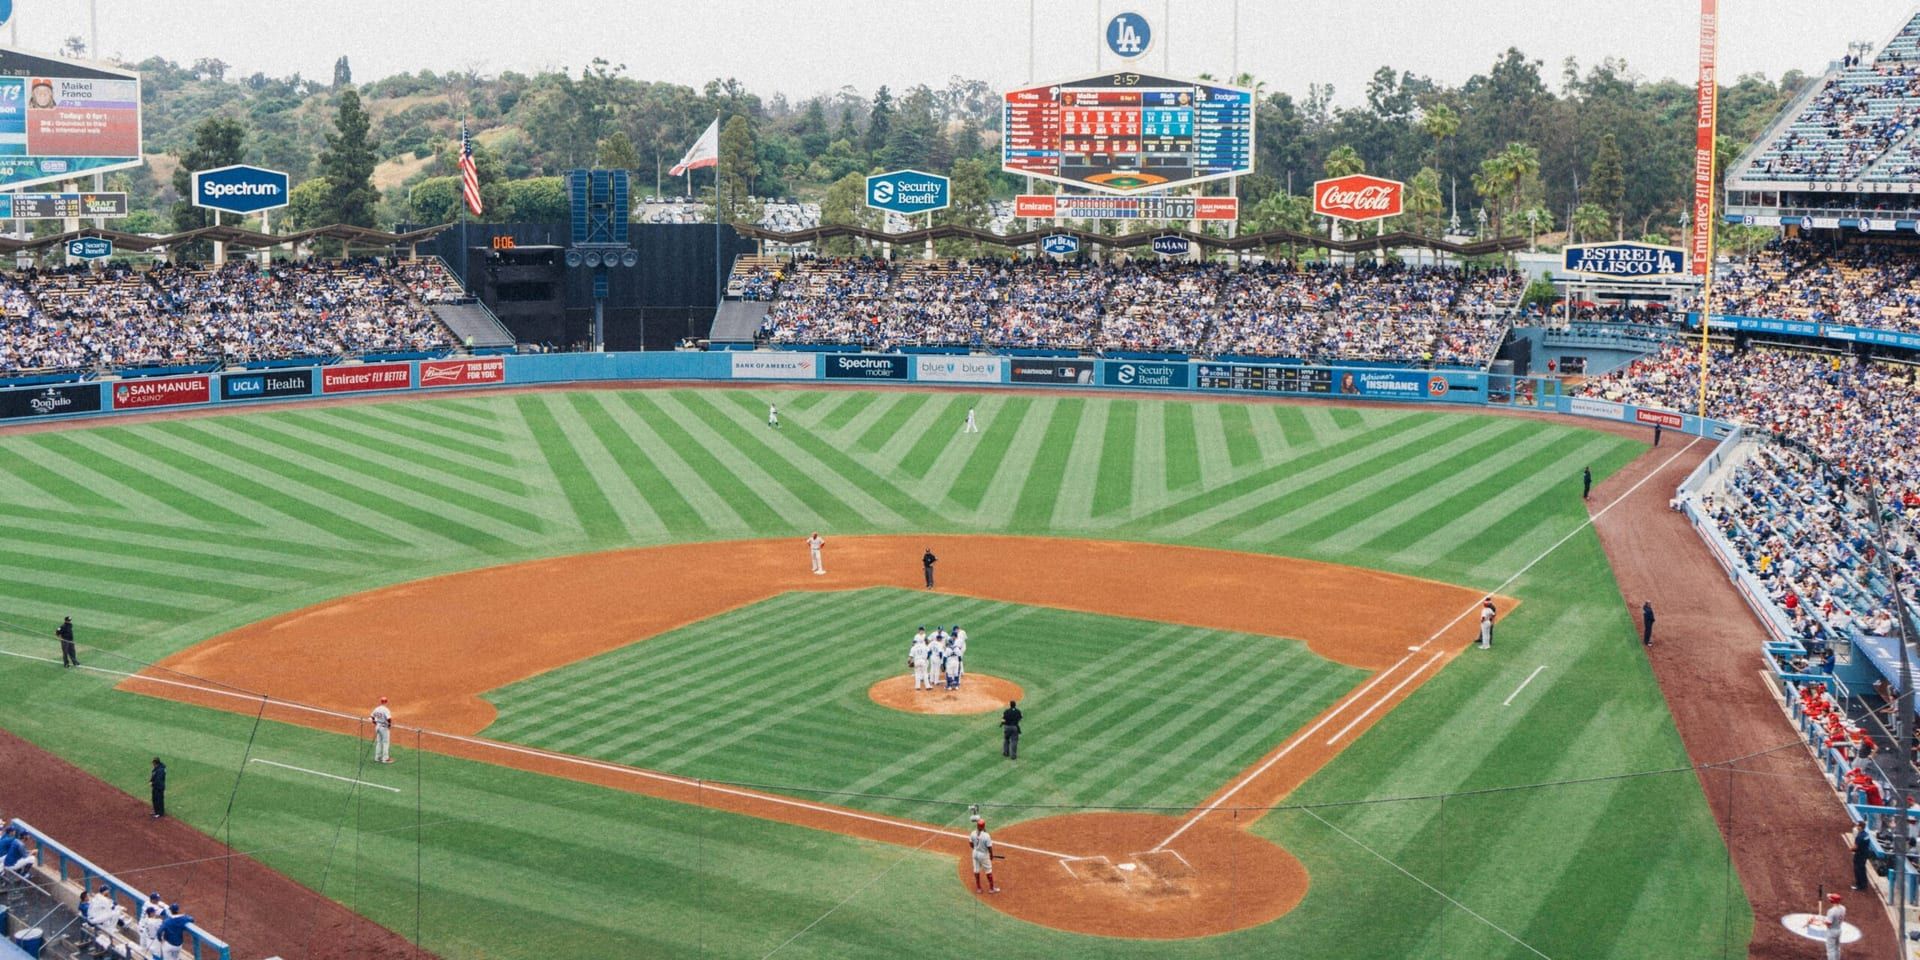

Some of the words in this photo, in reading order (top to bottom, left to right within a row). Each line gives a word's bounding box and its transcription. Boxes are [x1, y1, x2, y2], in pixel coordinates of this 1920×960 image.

[1117, 18, 1141, 52] LA
[1701, 14, 1715, 45] BETTER
[1113, 75, 1140, 86] 2:57
[62, 90, 92, 98] Franco
[1214, 94, 1240, 102] Dodgers
[1698, 66, 1712, 128] Emirates
[1697, 149, 1710, 180] BETTER
[204, 181, 276, 198] Spectrum
[898, 181, 941, 196] Security
[1696, 182, 1708, 200] FLY
[898, 194, 936, 204] Benefit
[1020, 202, 1052, 210] Emirates
[1166, 205, 1173, 217] 0
[1176, 205, 1183, 217] 0
[1186, 205, 1193, 217] 2
[1694, 201, 1708, 262] Emirates
[84, 242, 108, 250] Security
[1044, 238, 1057, 250] JIM
[1058, 236, 1076, 250] BEAM
[1155, 241, 1187, 250] DASANI
[1573, 260, 1652, 274] JALISCO
[1672, 314, 1685, 322] 2:57
[467, 363, 482, 371] THIS
[483, 362, 502, 370] BUD'S
[838, 357, 890, 370] Spectrum
[922, 362, 944, 372] blue
[962, 363, 984, 373] blue
[481, 370, 496, 378] YOU.
[866, 368, 891, 376] mobile
[1138, 366, 1174, 377] Security
[326, 374, 369, 386] Emirates
[372, 373, 383, 382] FLY
[384, 370, 408, 382] BETTER
[1139, 376, 1169, 385] Benefit
[130, 384, 158, 395] SAN
[160, 380, 206, 392] MANUEL
[232, 381, 260, 392] UCLA
[266, 377, 305, 390] Health
[1366, 380, 1419, 392] INSURANCE
[1430, 381, 1444, 391] 76
[130, 394, 161, 403] CASINO
